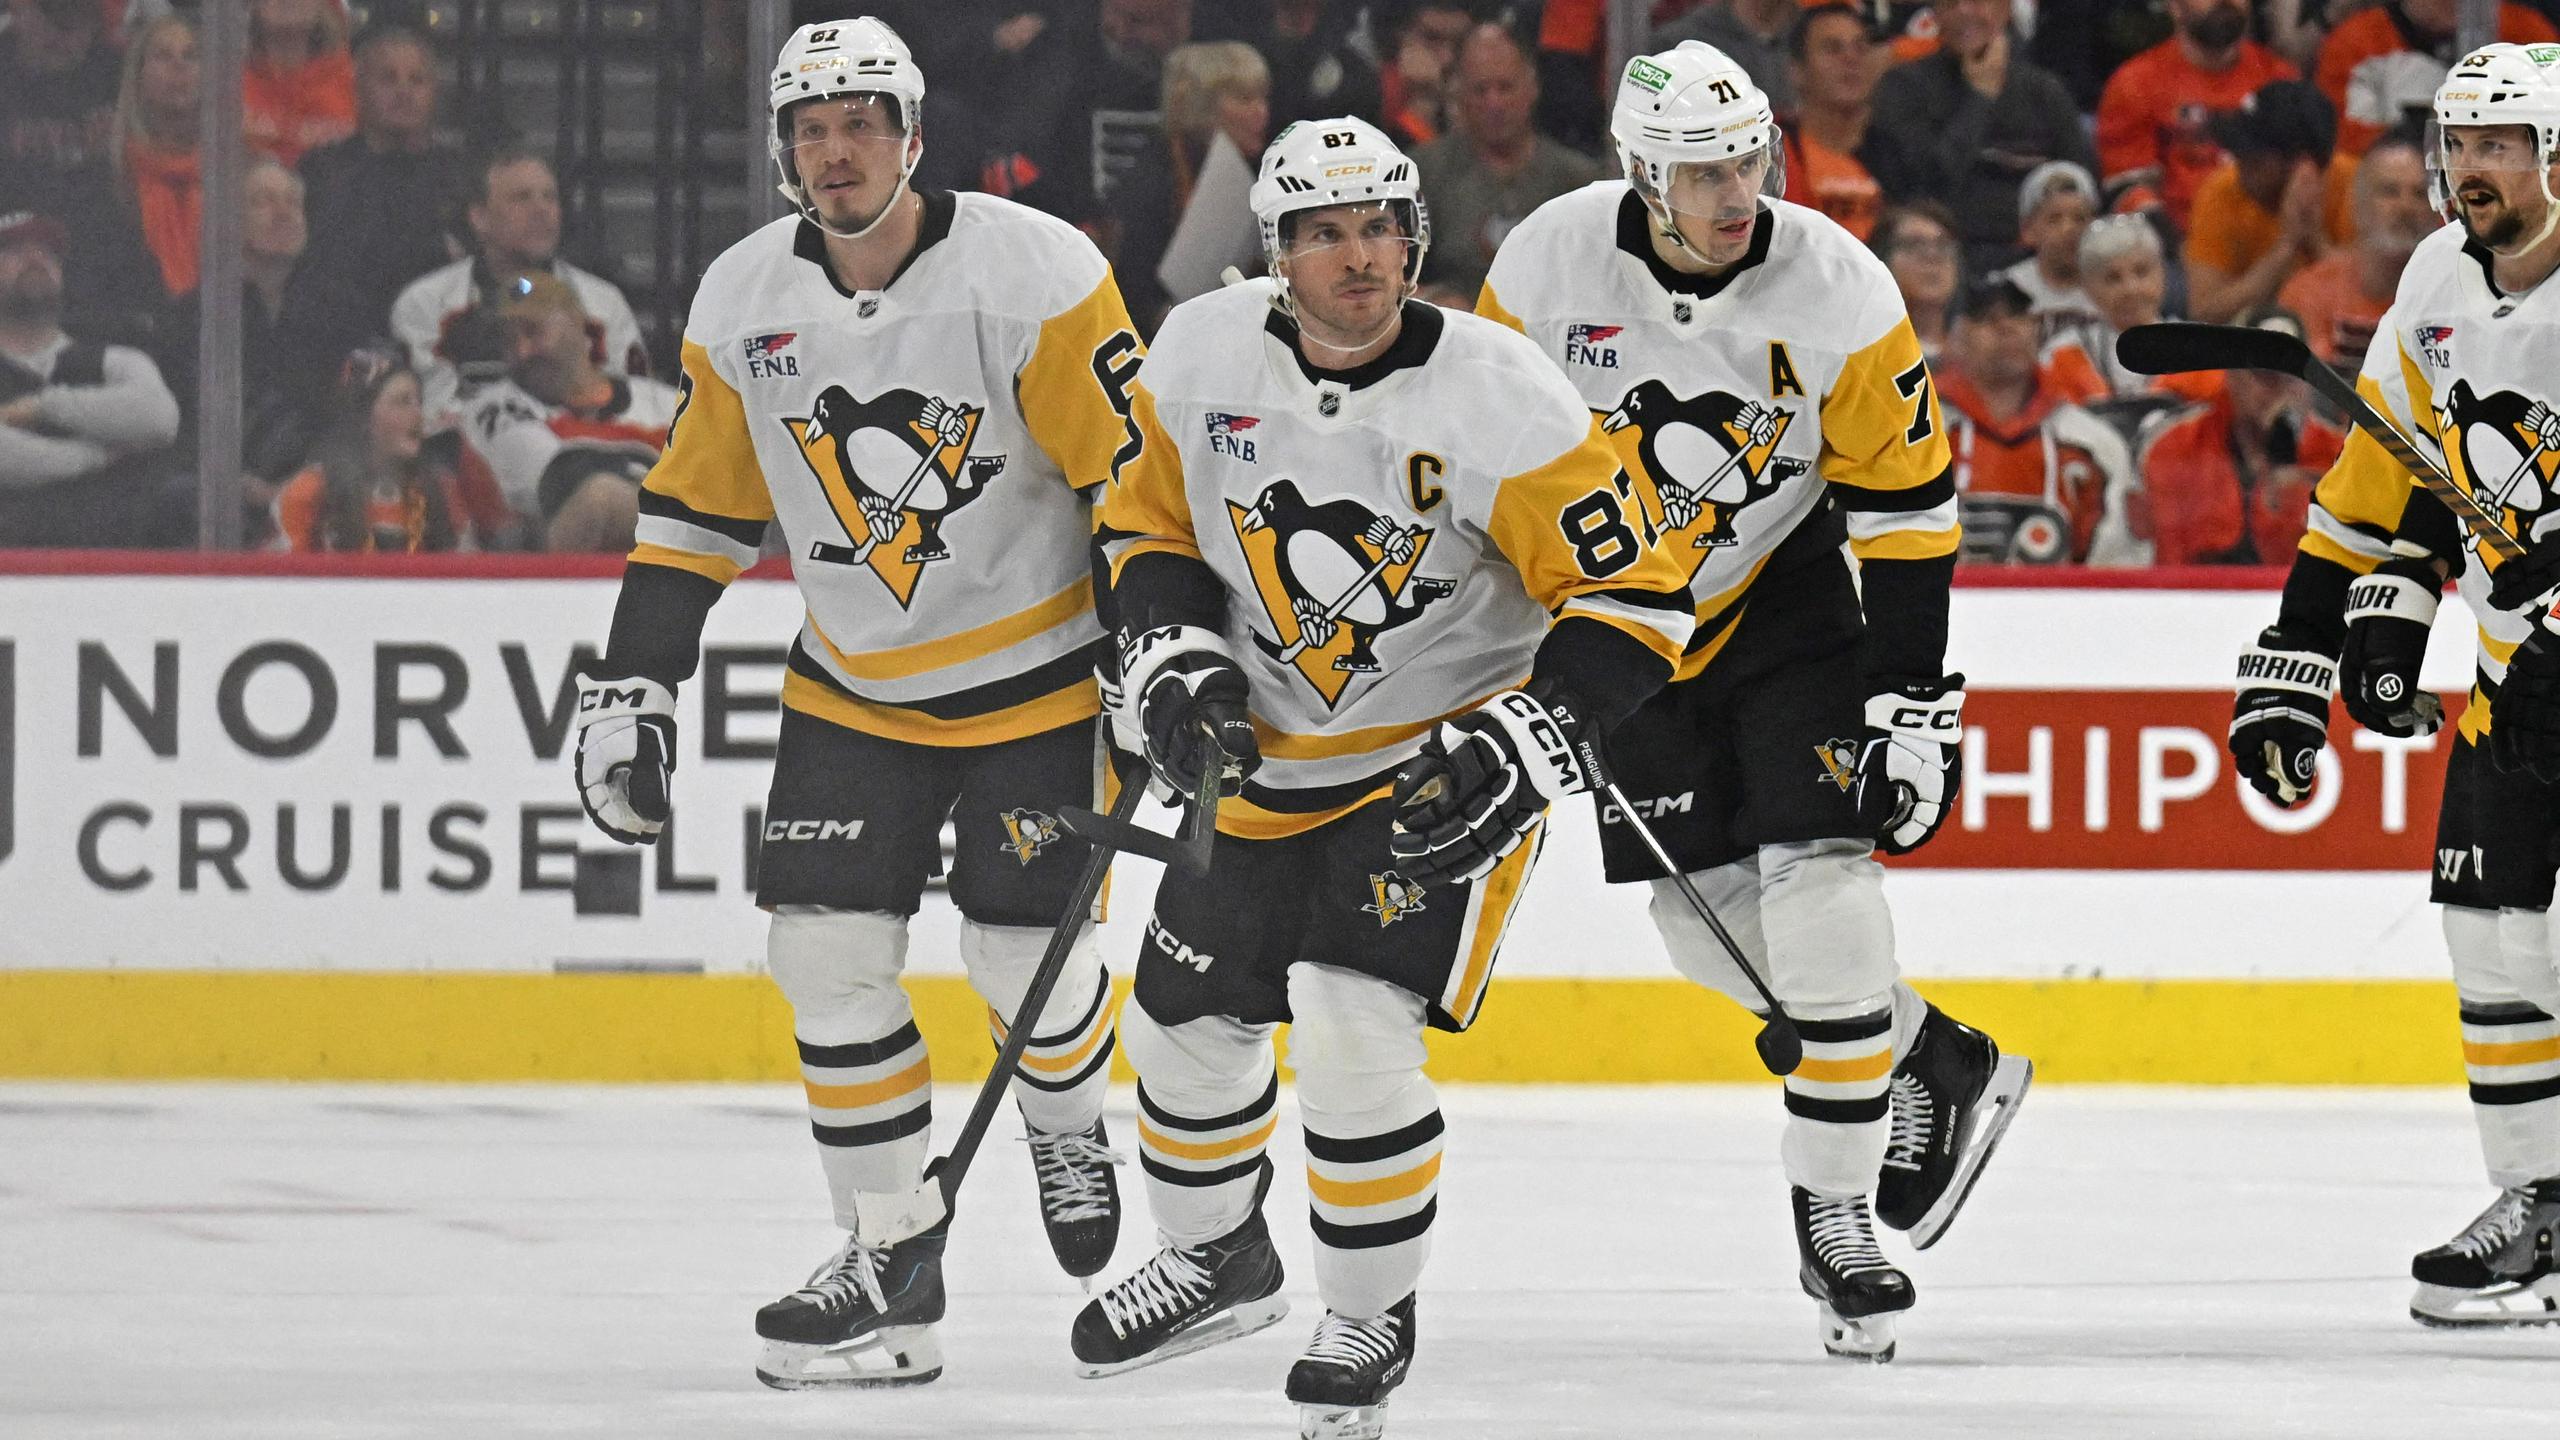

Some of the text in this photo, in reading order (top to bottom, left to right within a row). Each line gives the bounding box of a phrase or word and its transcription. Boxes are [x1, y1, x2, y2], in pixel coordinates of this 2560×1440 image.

[810, 29, 840, 43] 67
[1629, 60, 1669, 89] MSA
[1708, 79, 1742, 104] 71
[2444, 91, 2481, 102] CCM
[1322, 131, 1358, 149] 87
[1325, 164, 1374, 178] CCM
[748, 355, 801, 379] F.N.B.
[1567, 342, 1620, 370] F.N.B.
[1767, 339, 1807, 400] A
[1891, 352, 1934, 448] 7
[1209, 434, 1258, 465] F.N.B.
[1407, 451, 1447, 517] C
[1117, 625, 1131, 650] 87
[1121, 625, 1183, 678] CM
[2236, 653, 2333, 692] ARRIOR
[76, 639, 789, 761] NORWE
[580, 687, 648, 713] CM
[1552, 705, 1576, 725] 87
[1890, 707, 1961, 730] CC
[1500, 694, 1579, 788] CCM
[1578, 740, 1606, 790] PENGUINS
[1960, 725, 2439, 835] HIPOT
[764, 819, 865, 843] CCM
[76, 802, 586, 893] CRUISE
[1147, 910, 1215, 974] CCM
